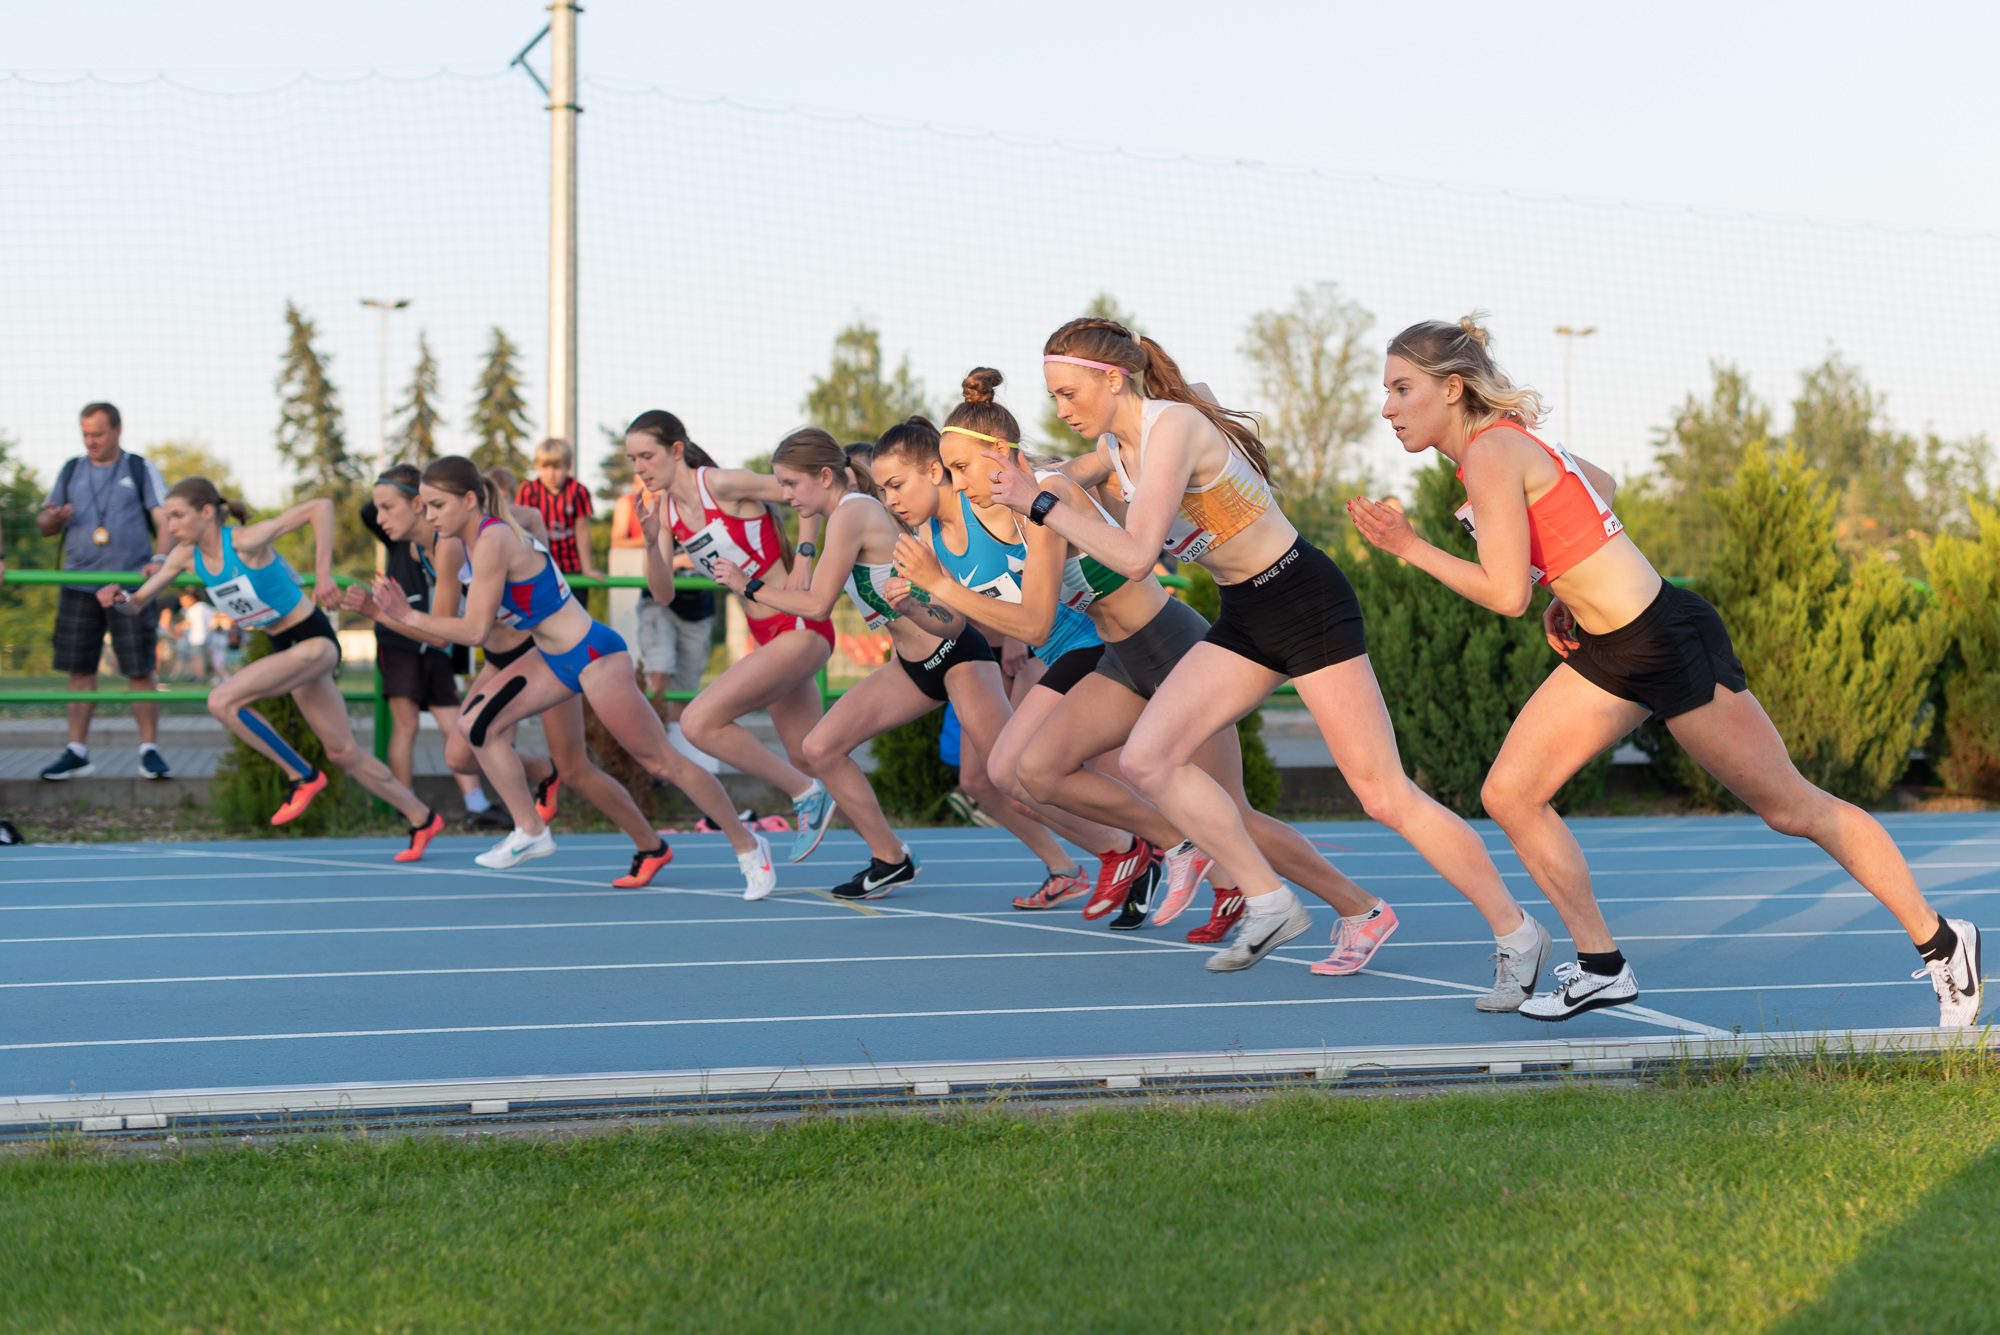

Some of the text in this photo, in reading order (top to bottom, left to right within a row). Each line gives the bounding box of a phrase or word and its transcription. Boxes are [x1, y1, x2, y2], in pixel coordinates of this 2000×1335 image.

[1187, 537, 1208, 556] 2021
[1253, 548, 1300, 588] NIKE PRO
[923, 654, 942, 671] NIKE
